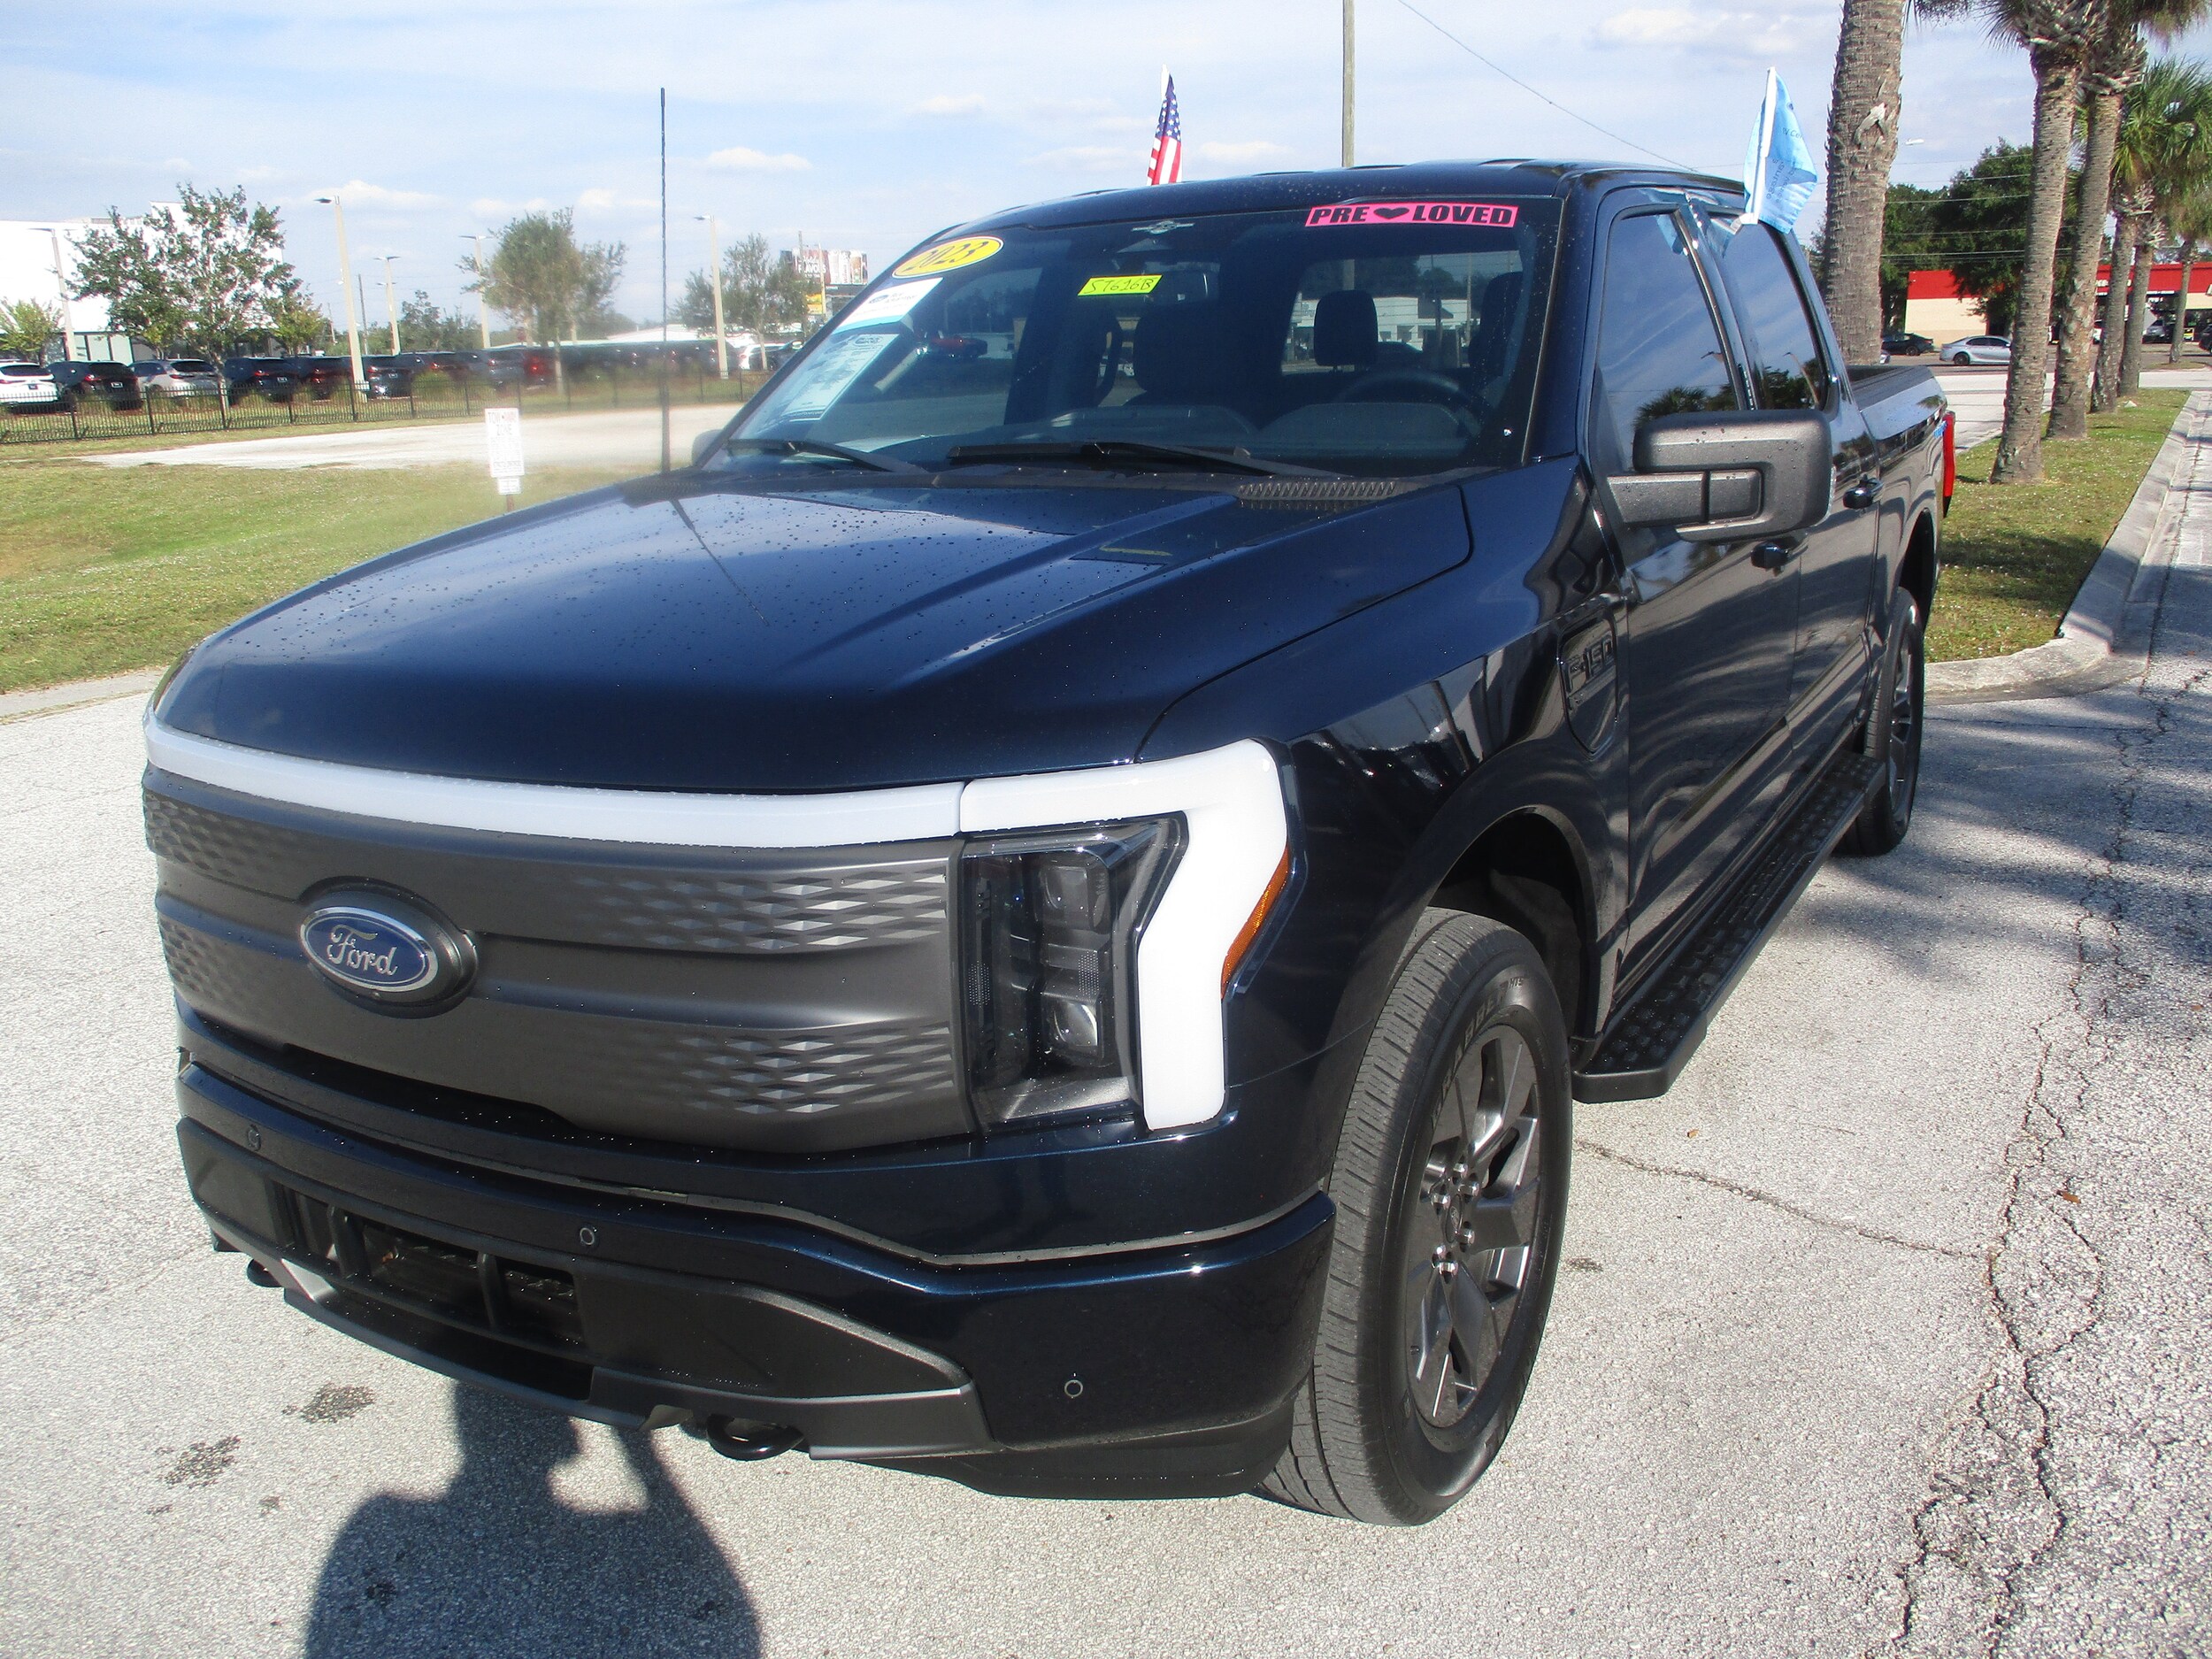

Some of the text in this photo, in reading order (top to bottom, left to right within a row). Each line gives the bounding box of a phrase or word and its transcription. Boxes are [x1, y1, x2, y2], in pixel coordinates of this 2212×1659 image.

[1310, 205, 1513, 225] PRE LOVED
[902, 241, 989, 272] 2023
[326, 924, 398, 976] Ford
